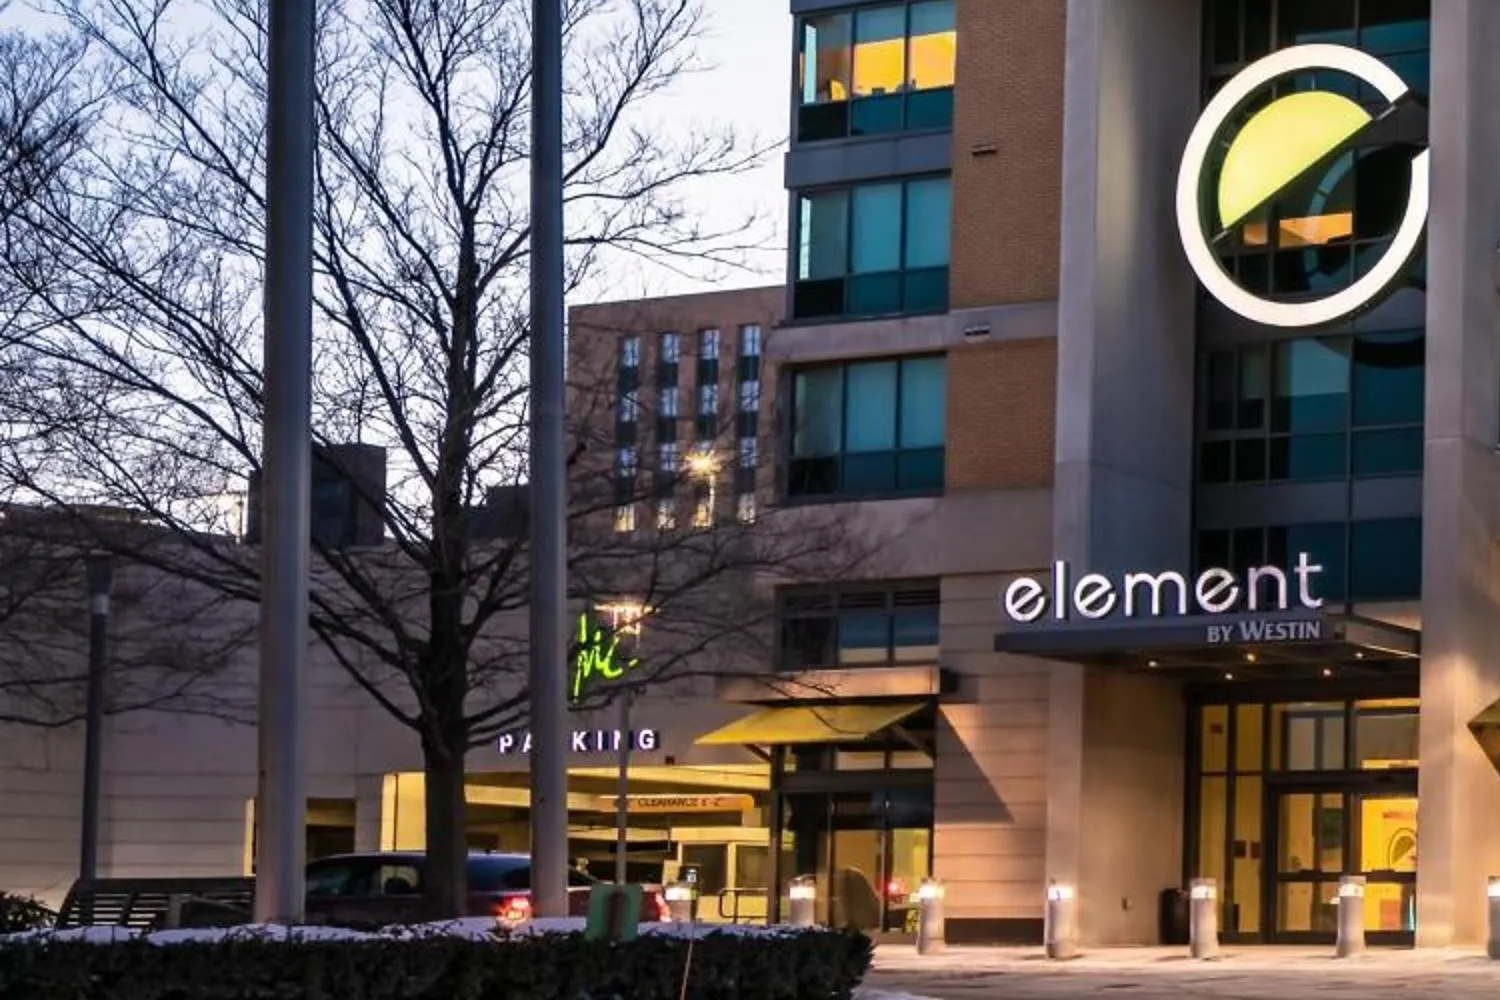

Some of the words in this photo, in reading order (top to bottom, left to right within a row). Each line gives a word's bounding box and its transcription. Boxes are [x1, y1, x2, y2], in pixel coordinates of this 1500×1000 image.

[1005, 552, 1324, 622] element
[1207, 625, 1233, 643] BY
[1240, 620, 1320, 641] WESTIN
